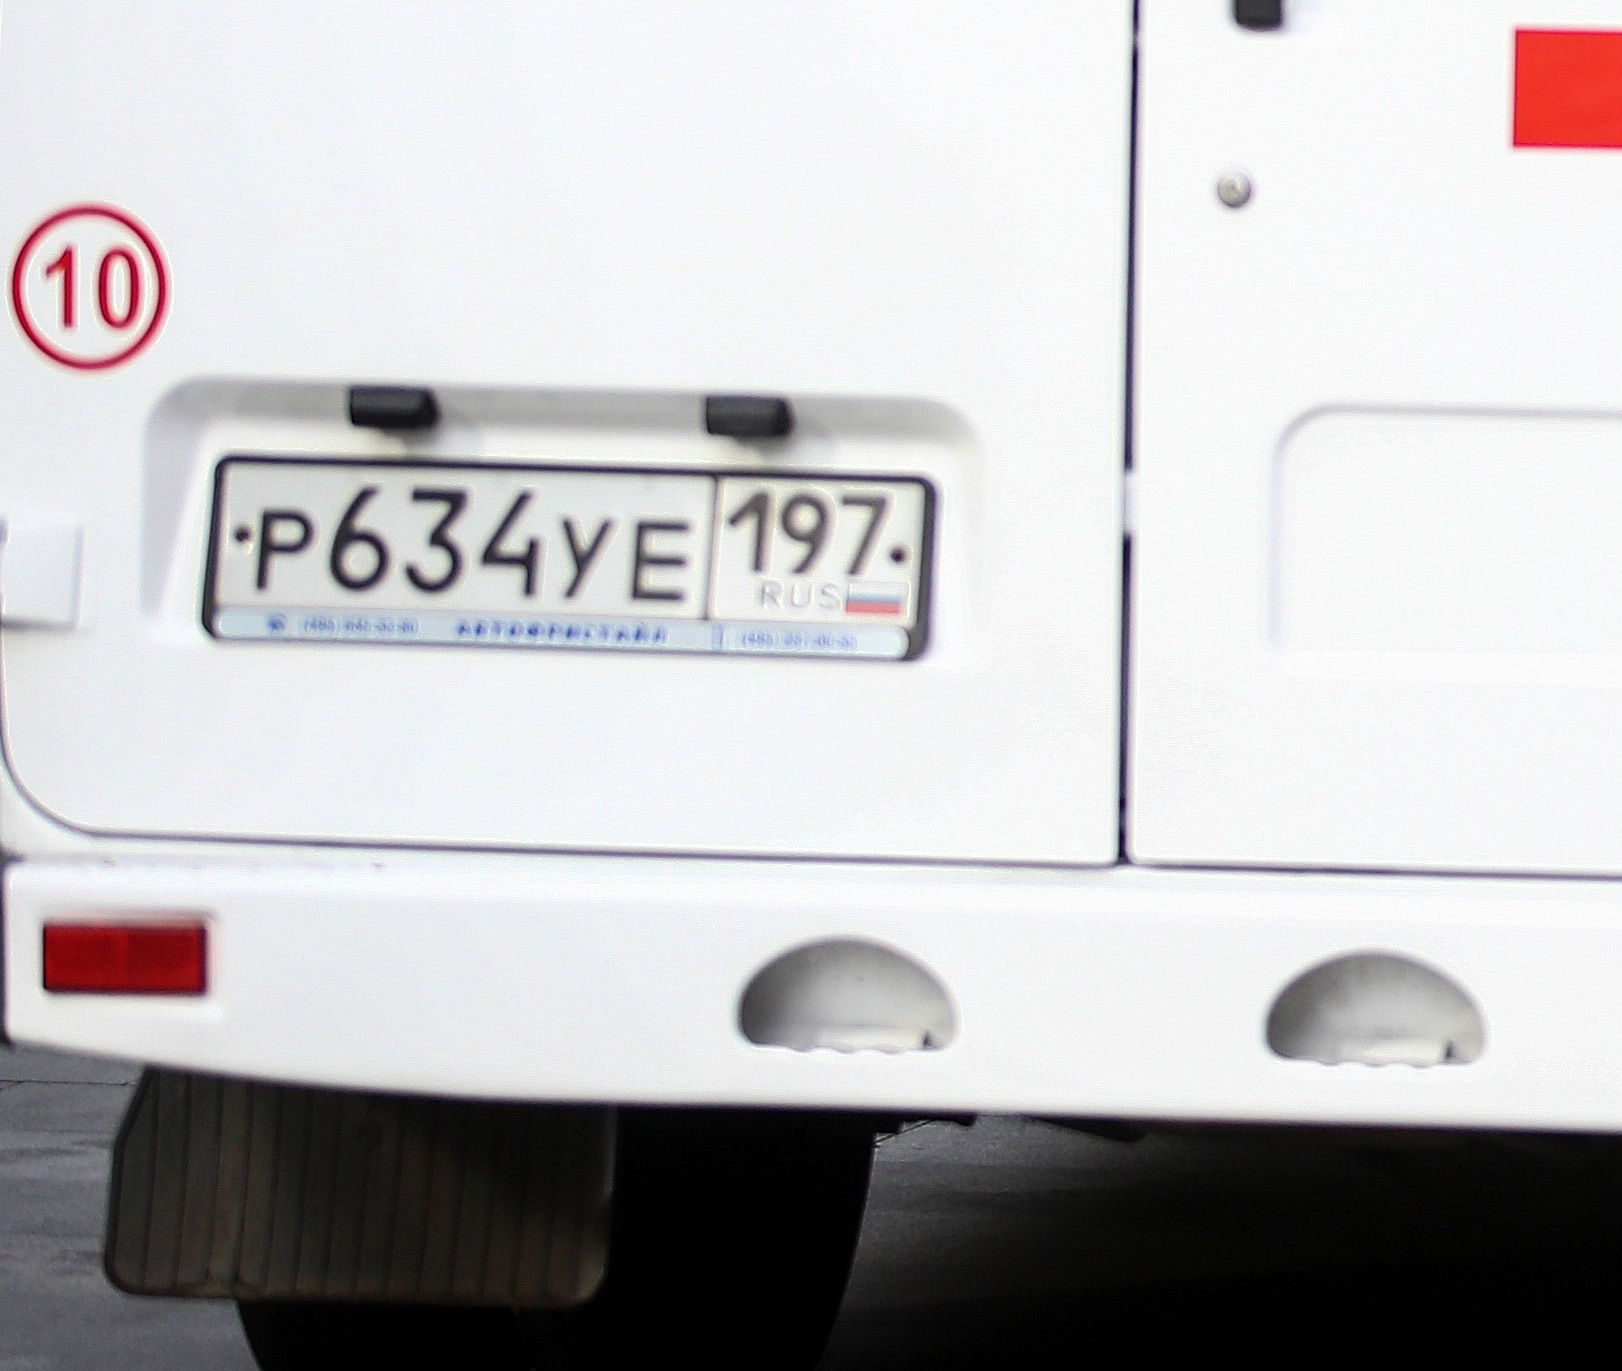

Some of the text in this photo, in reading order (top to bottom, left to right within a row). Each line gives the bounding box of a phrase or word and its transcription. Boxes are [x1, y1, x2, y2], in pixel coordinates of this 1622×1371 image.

[46, 246, 140, 329] 10
[257, 487, 890, 601] Р634УЕ 197
[760, 581, 841, 610] RUS
